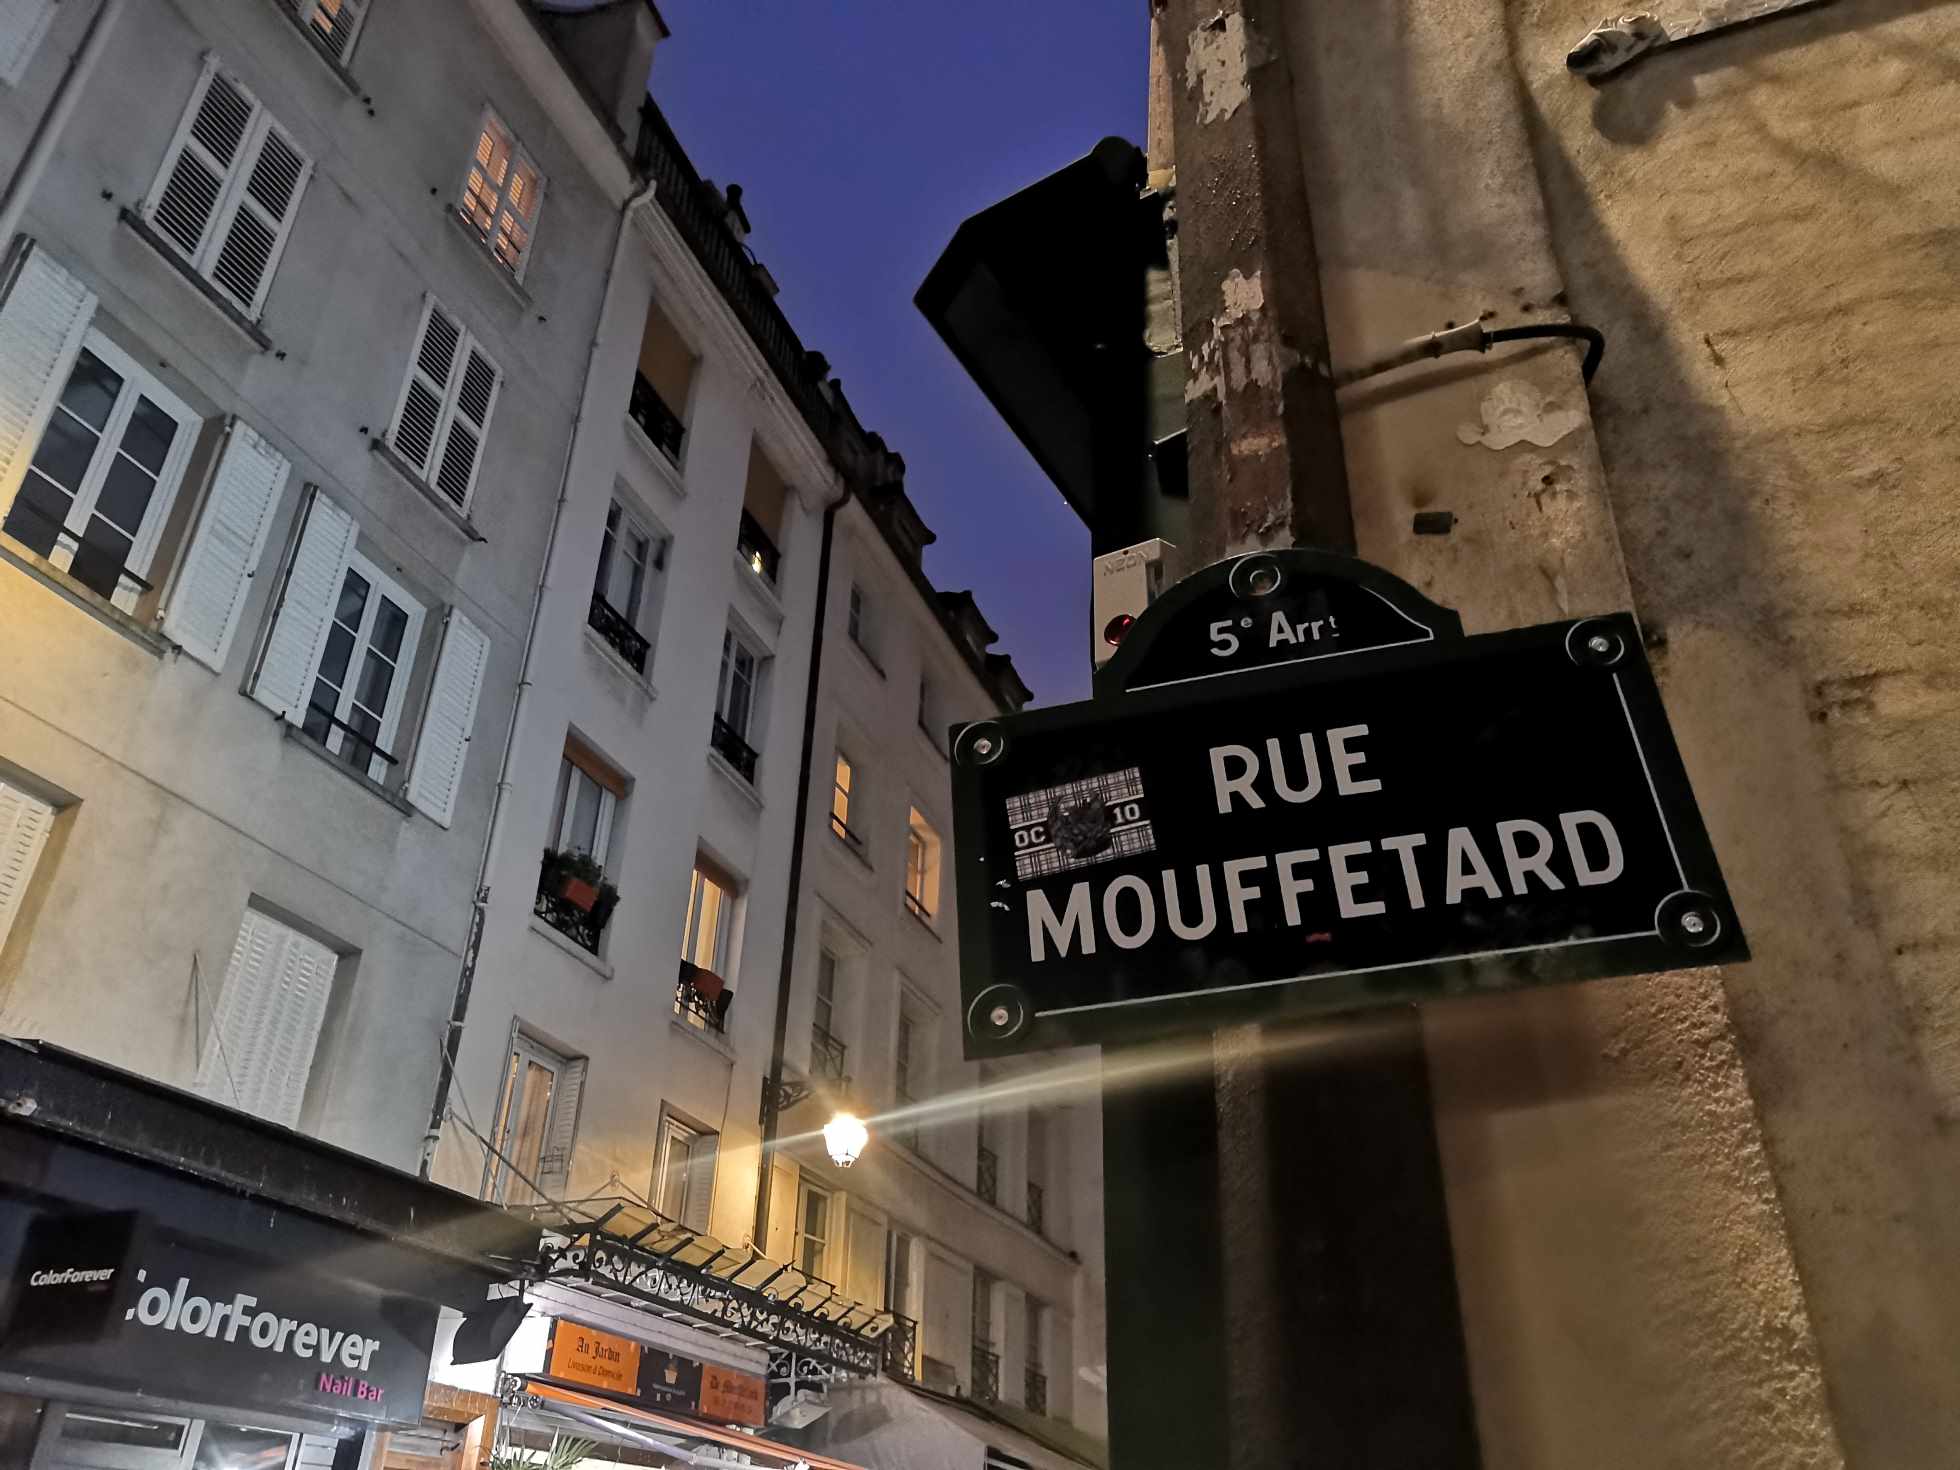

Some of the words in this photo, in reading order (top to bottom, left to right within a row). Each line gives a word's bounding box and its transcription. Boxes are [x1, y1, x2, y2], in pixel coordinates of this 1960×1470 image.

[1209, 724, 1383, 813] RUE
[1112, 803, 1140, 824] 10
[1026, 809, 1625, 963] MOUFFETARD
[30, 1268, 115, 1286] ColorForever
[576, 1336, 590, 1354] Au
[318, 1372, 354, 1398] Nail
[357, 1381, 385, 1403] Bar
